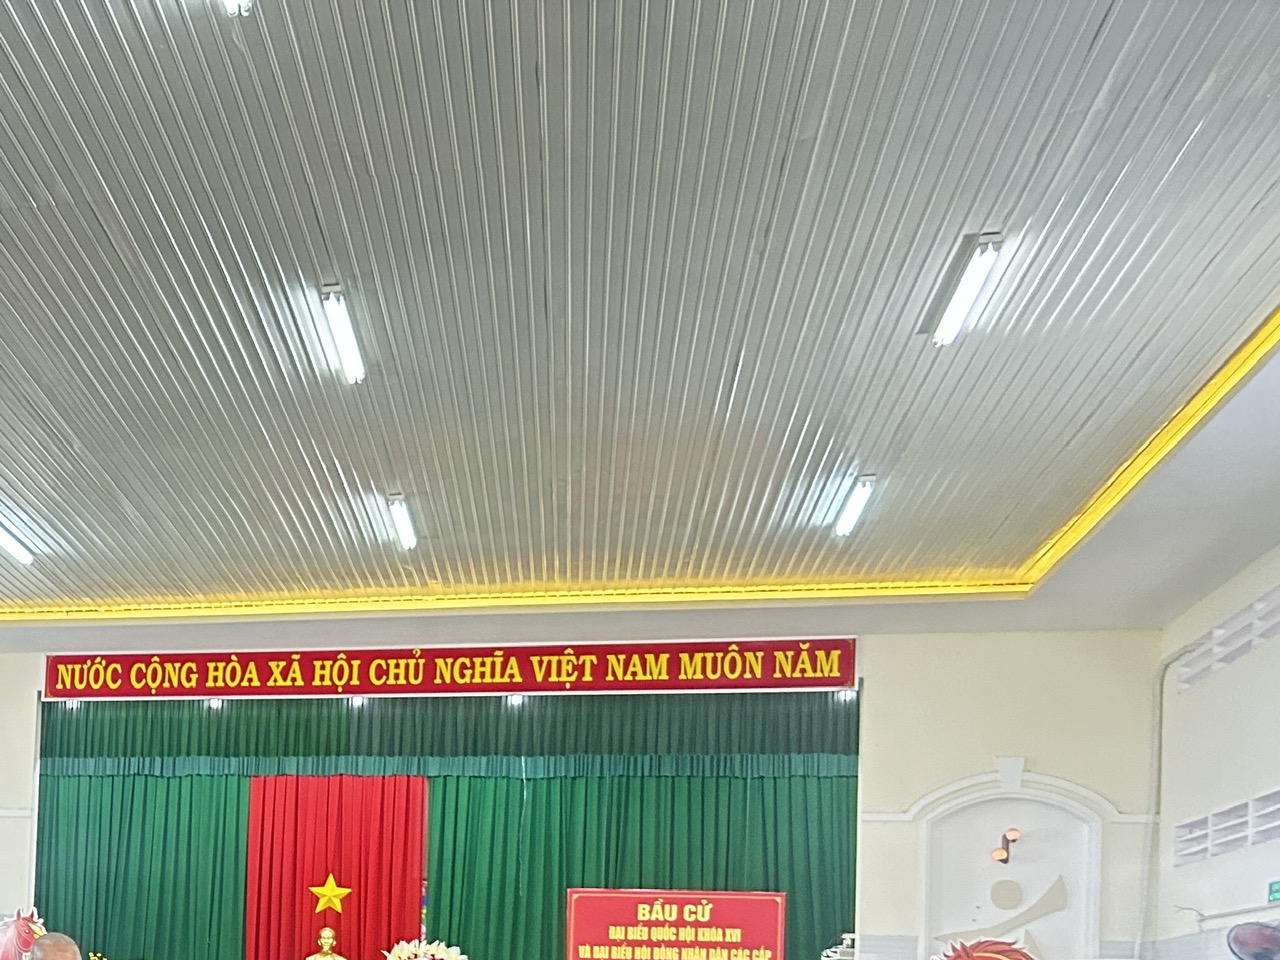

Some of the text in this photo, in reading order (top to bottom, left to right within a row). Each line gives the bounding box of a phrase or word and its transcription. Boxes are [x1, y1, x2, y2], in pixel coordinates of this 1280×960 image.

[56, 642, 842, 694] NƯỚC CỘNG HÒA XÃ HỘI CHỦ NGHĨA VIỆT NAM MUÔN NĂM
[637, 898, 714, 922] BẦU CỬ
[724, 928, 741, 943] XVI
